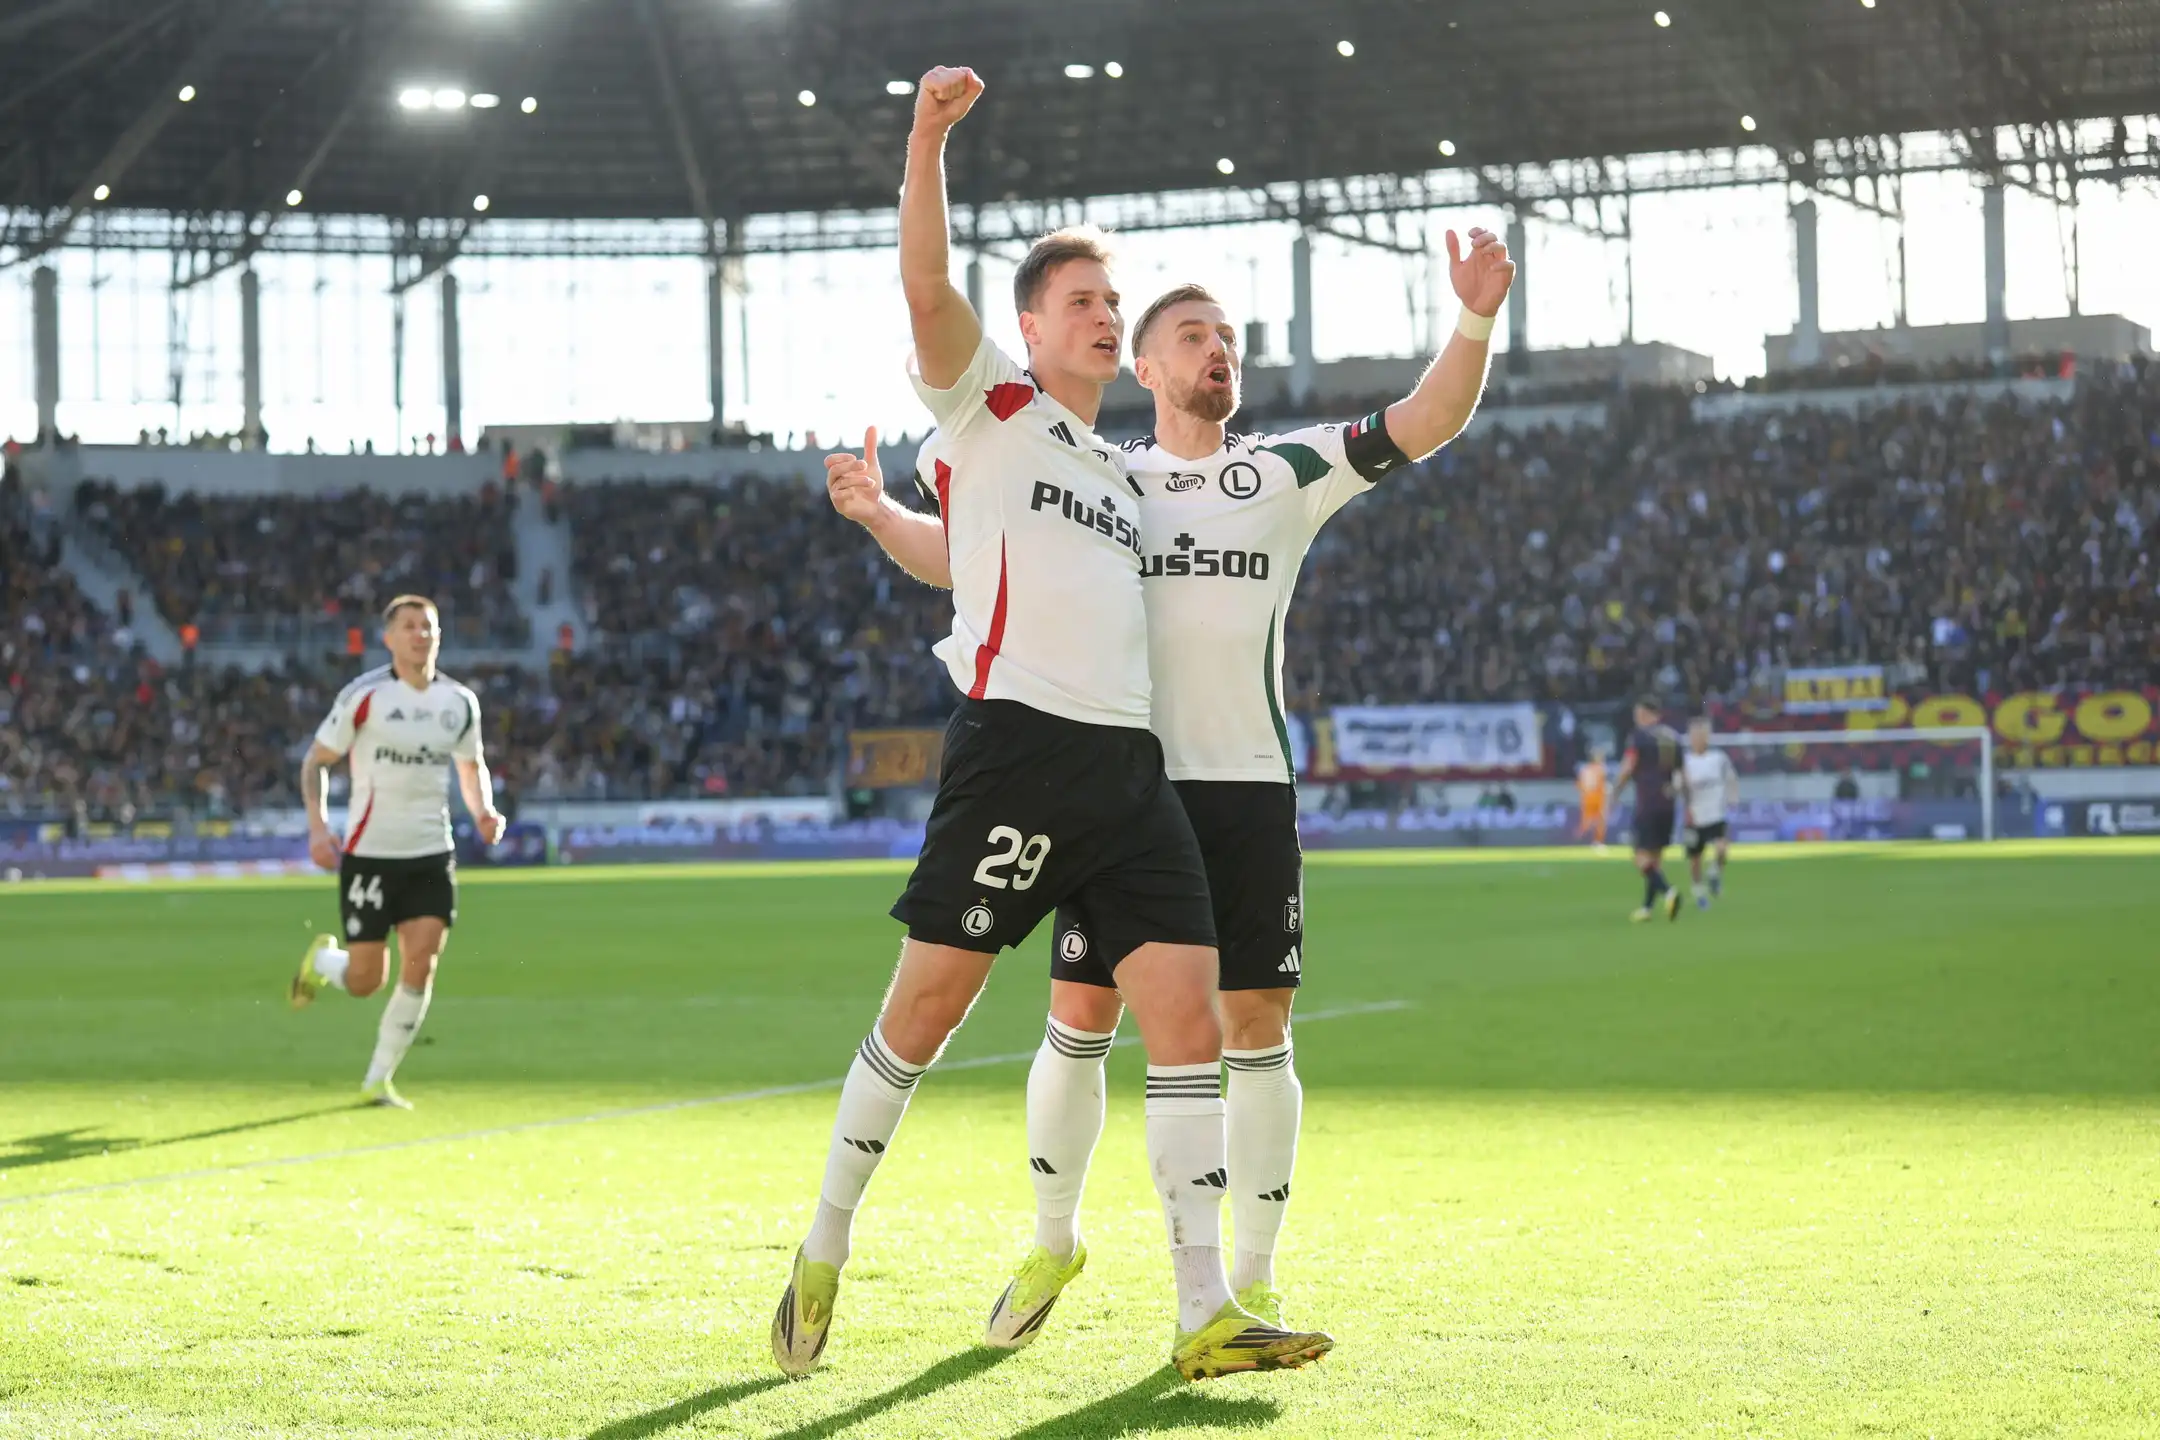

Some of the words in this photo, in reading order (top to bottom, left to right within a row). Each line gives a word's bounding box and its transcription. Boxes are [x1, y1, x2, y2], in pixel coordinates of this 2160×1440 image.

[1173, 477, 1199, 490] LOTTO
[1231, 469, 1251, 492] L
[375, 746, 450, 766] Plus
[973, 825, 1052, 891] 29
[348, 873, 384, 910] 44
[970, 912, 982, 931] L
[1066, 937, 1077, 955] L
